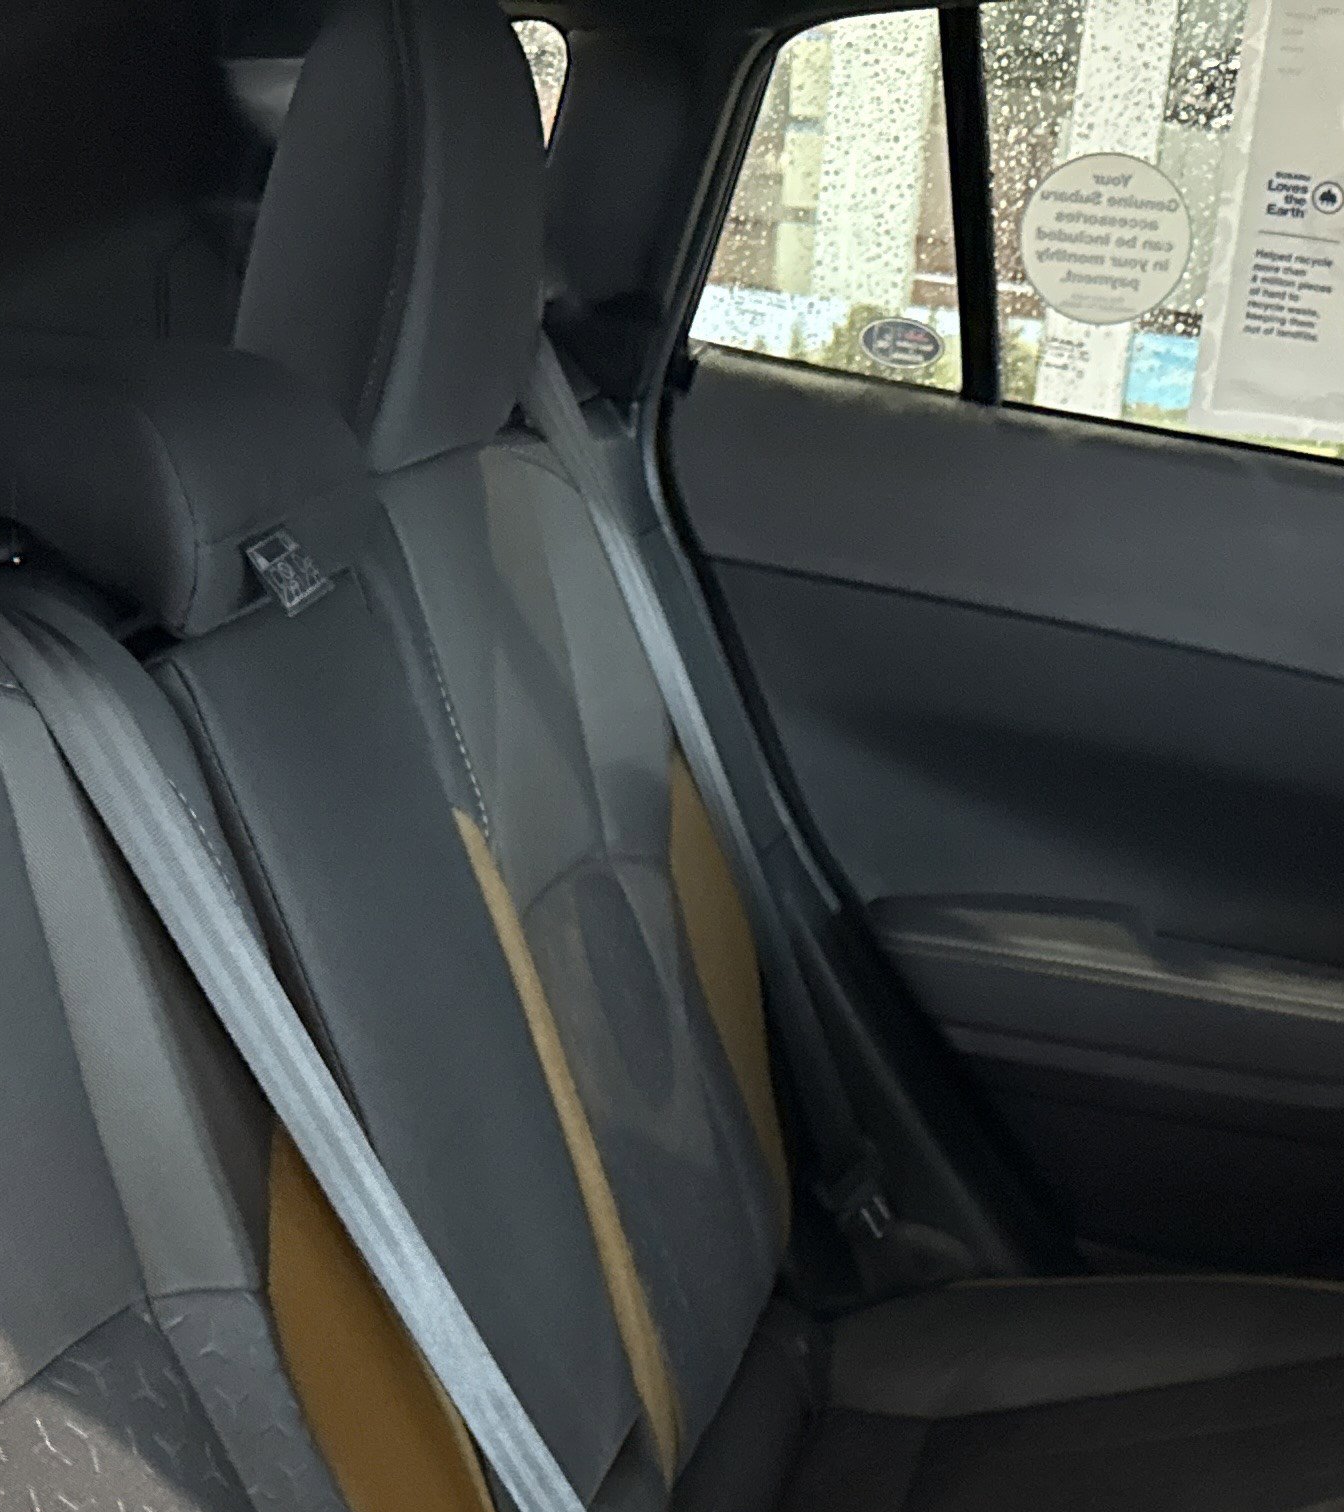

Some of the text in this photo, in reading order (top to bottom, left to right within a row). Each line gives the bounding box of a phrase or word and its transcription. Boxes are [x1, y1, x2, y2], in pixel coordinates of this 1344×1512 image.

[1267, 179, 1309, 194] Loves
[1284, 194, 1307, 206] the
[1266, 203, 1305, 219] Earth
